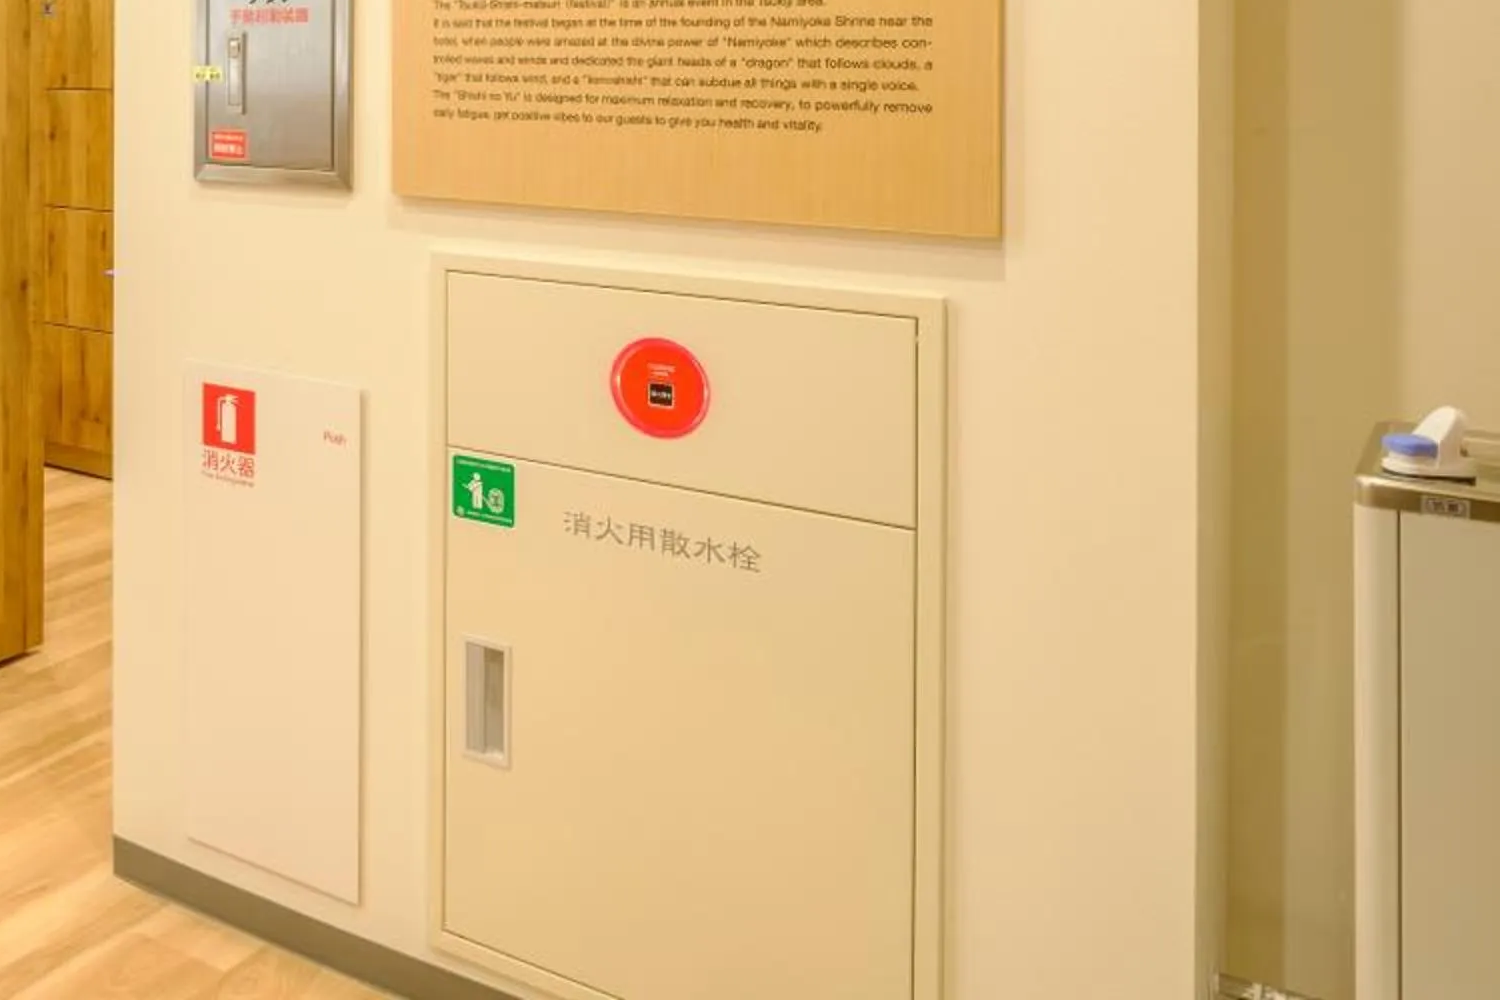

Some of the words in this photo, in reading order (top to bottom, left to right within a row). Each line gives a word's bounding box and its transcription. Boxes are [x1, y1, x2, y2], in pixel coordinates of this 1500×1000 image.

[644, 15, 657, 28] of
[658, 14, 678, 28] the
[679, 14, 731, 31] founding
[732, 14, 746, 28] of
[746, 14, 767, 28] the
[768, 13, 832, 30] Namiyoke
[833, 12, 876, 27] Shrine
[877, 15, 907, 27] near
[910, 12, 933, 27] the
[666, 37, 703, 51] power
[706, 34, 719, 48] of
[794, 34, 832, 48] which
[834, 34, 897, 48] describes
[900, 36, 931, 48] con-
[645, 54, 673, 71] giant
[676, 54, 712, 68] heads
[713, 54, 727, 68] of
[728, 57, 737, 68] a
[796, 55, 822, 69] that
[824, 55, 870, 70] follows
[871, 55, 919, 72] clouds,
[922, 58, 933, 70] a
[649, 74, 672, 87] that
[673, 76, 696, 88] can
[697, 74, 742, 88] subdue
[742, 75, 758, 89] all
[759, 75, 797, 92] things
[799, 75, 827, 90] with
[828, 78, 837, 90] a
[839, 76, 879, 94] single
[880, 76, 918, 91] voice.
[656, 93, 713, 108] relaxation
[714, 94, 738, 109] and
[739, 97, 795, 113] recovery,
[797, 96, 812, 110] to
[813, 96, 880, 115] powerfully
[882, 100, 933, 113] remove
[653, 113, 666, 126] to
[667, 113, 692, 130] give
[693, 116, 716, 131] you
[717, 114, 754, 129] health
[756, 115, 780, 130] and
[782, 116, 822, 134] vitality.
[323, 430, 347, 446] Push
[201, 447, 255, 478] 消火器
[562, 510, 763, 573] 消火用散水栓
